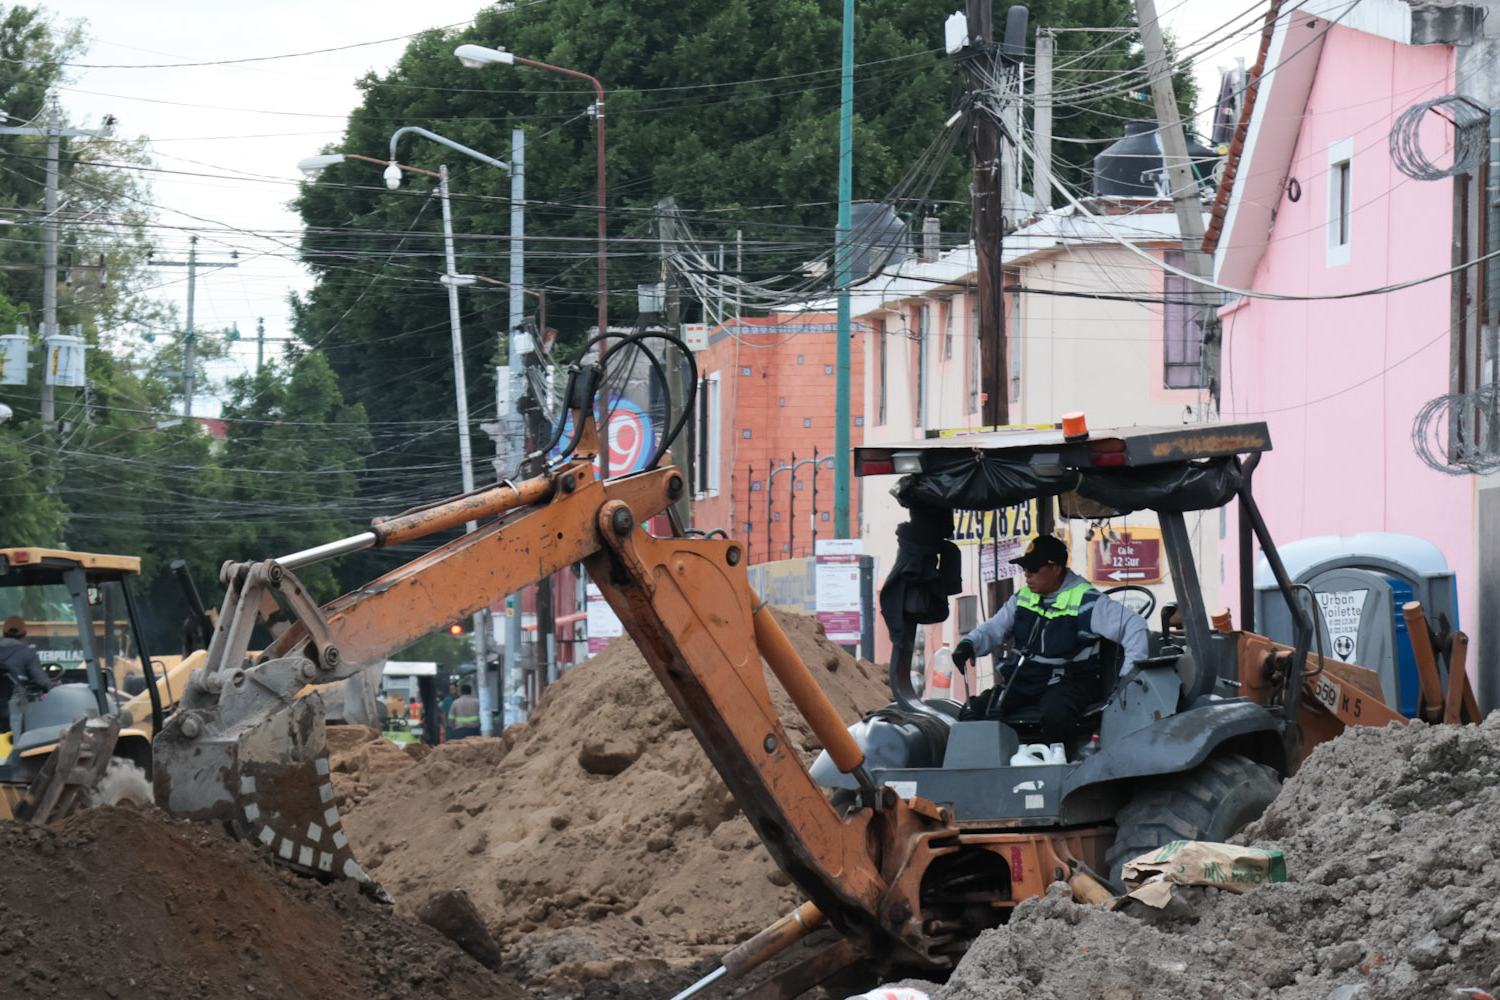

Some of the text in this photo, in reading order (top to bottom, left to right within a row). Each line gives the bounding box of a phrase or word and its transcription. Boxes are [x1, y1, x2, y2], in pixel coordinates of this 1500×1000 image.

[1112, 557, 1140, 567] 12 Sur
[1320, 593, 1355, 606] Urban
[1322, 605, 1361, 618] Toilette
